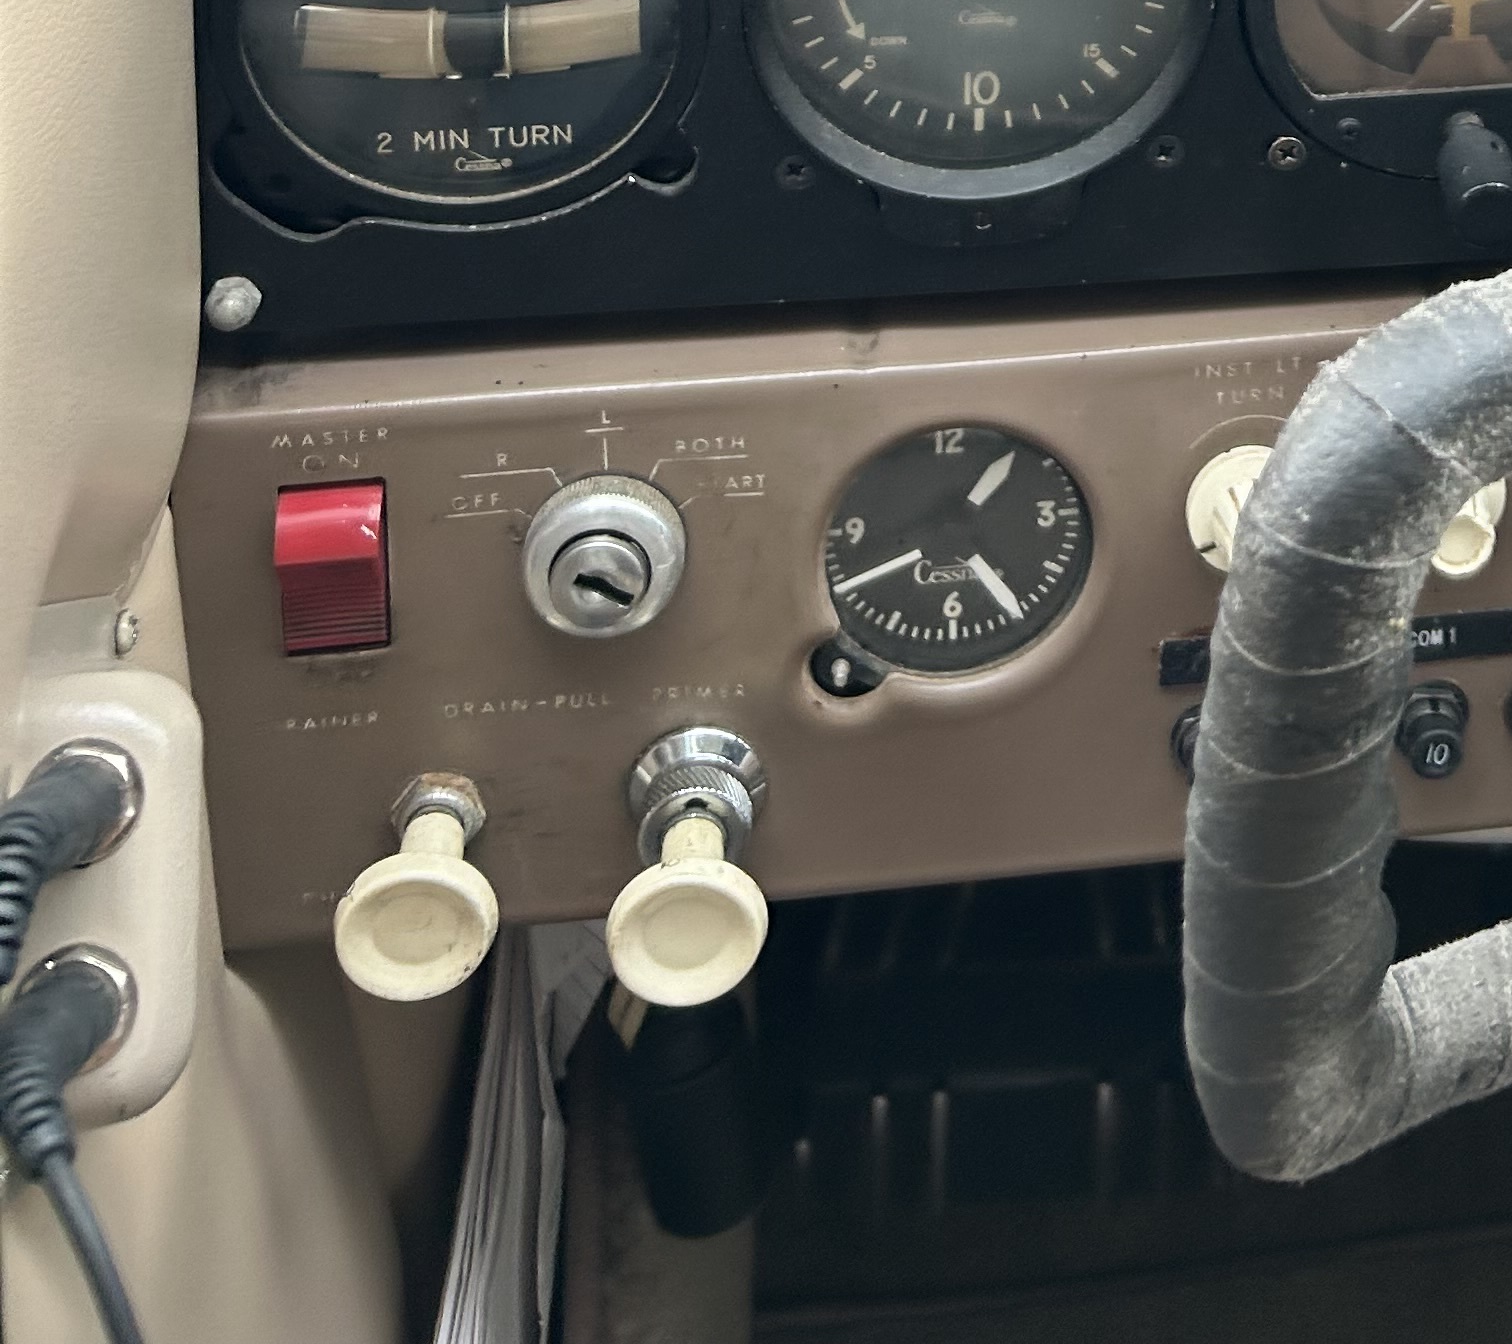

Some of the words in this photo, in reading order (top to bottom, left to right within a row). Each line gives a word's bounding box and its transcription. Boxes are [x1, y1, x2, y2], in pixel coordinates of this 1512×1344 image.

[1083, 44, 1100, 58] 15
[864, 55, 877, 69] 5
[963, 71, 1001, 106] 10
[377, 132, 392, 154] 2
[414, 128, 470, 152] MIN
[488, 124, 572, 148] TURN
[1195, 362, 1253, 378] INST
[1277, 357, 1301, 374] LT
[1216, 386, 1285, 405] TURN
[601, 410, 611, 423] L
[270, 427, 388, 448] MASTER
[675, 437, 745, 453] BOTH
[935, 428, 964, 454] 12
[302, 452, 359, 474] ON
[497, 453, 507, 466] R
[725, 474, 765, 489] ART
[452, 493, 500, 510] OFF
[1035, 500, 1056, 528] 3
[845, 517, 865, 544] 9
[943, 591, 963, 618] 6
[1450, 627, 1457, 644] 1
[653, 683, 744, 700] PRIMER
[1426, 743, 1450, 765] 10
